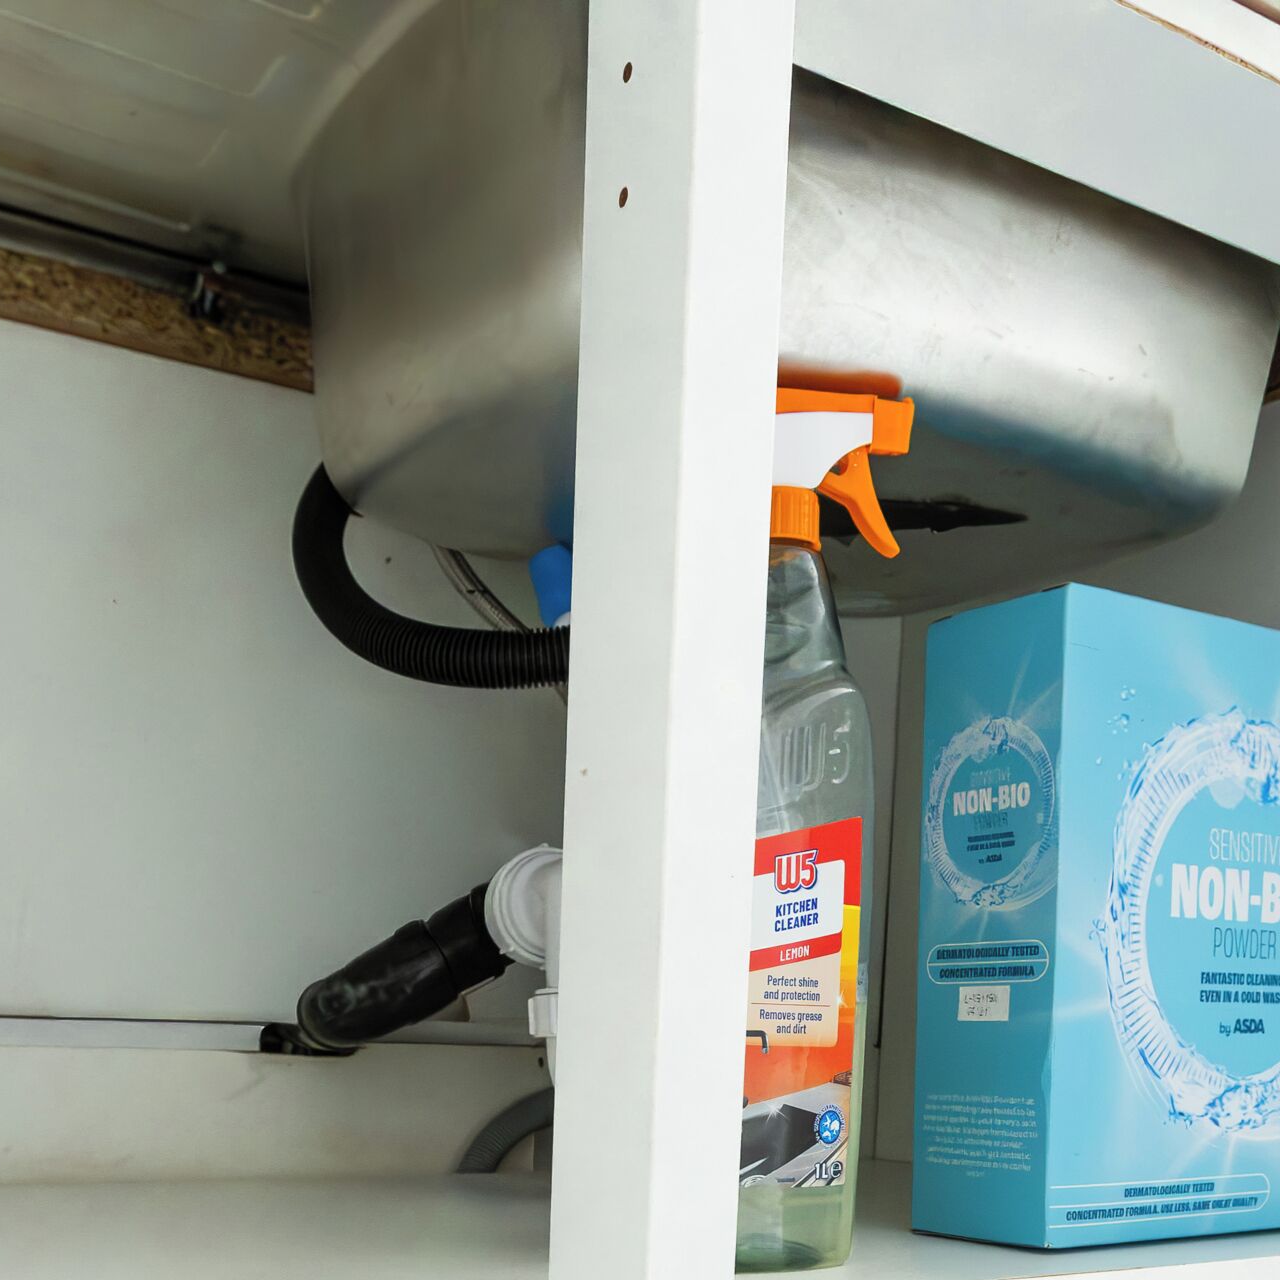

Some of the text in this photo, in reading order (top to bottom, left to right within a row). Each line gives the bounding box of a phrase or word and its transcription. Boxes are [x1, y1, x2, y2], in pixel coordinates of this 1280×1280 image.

[953, 782, 1030, 816] NON-BIO
[775, 849, 818, 893] W5
[775, 898, 818, 917] KITCHEN
[774, 913, 819, 932] CLEANER
[1213, 927, 1277, 959] POWDER
[780, 945, 810, 961] LEMON
[767, 974, 819, 988] Perfect shine
[1200, 972, 1245, 985] FANTASTIC
[763, 990, 821, 1002] and protection
[1200, 989, 1221, 1003] EVEN
[1223, 990, 1232, 1003] IN
[1233, 991, 1239, 1003] A
[1241, 991, 1261, 1004] COLD
[760, 1009, 823, 1023] Removes grease
[776, 1024, 807, 1035] and dirt
[1219, 1018, 1265, 1037] by ASDA
[1066, 1207, 1125, 1221] CONCENTRATED
